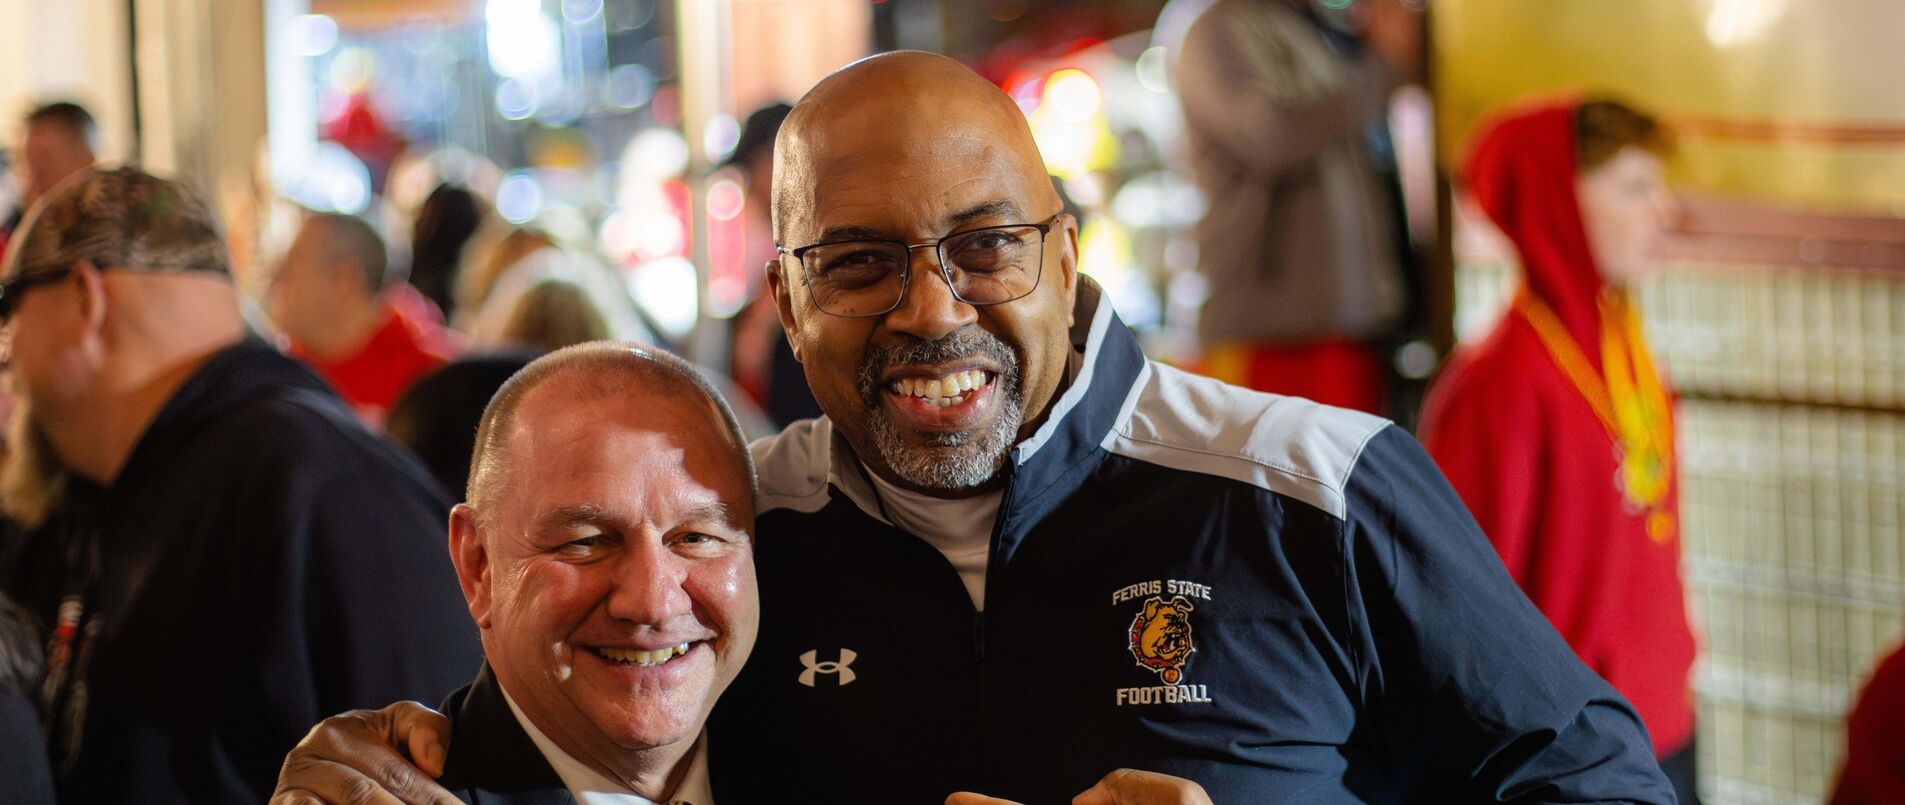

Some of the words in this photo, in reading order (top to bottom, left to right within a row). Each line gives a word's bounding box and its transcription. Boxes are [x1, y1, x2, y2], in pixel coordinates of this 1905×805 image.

[1112, 580, 1162, 606] FERRIS
[1167, 579, 1212, 600] STATE
[1116, 684, 1212, 706] FOOTBALL
